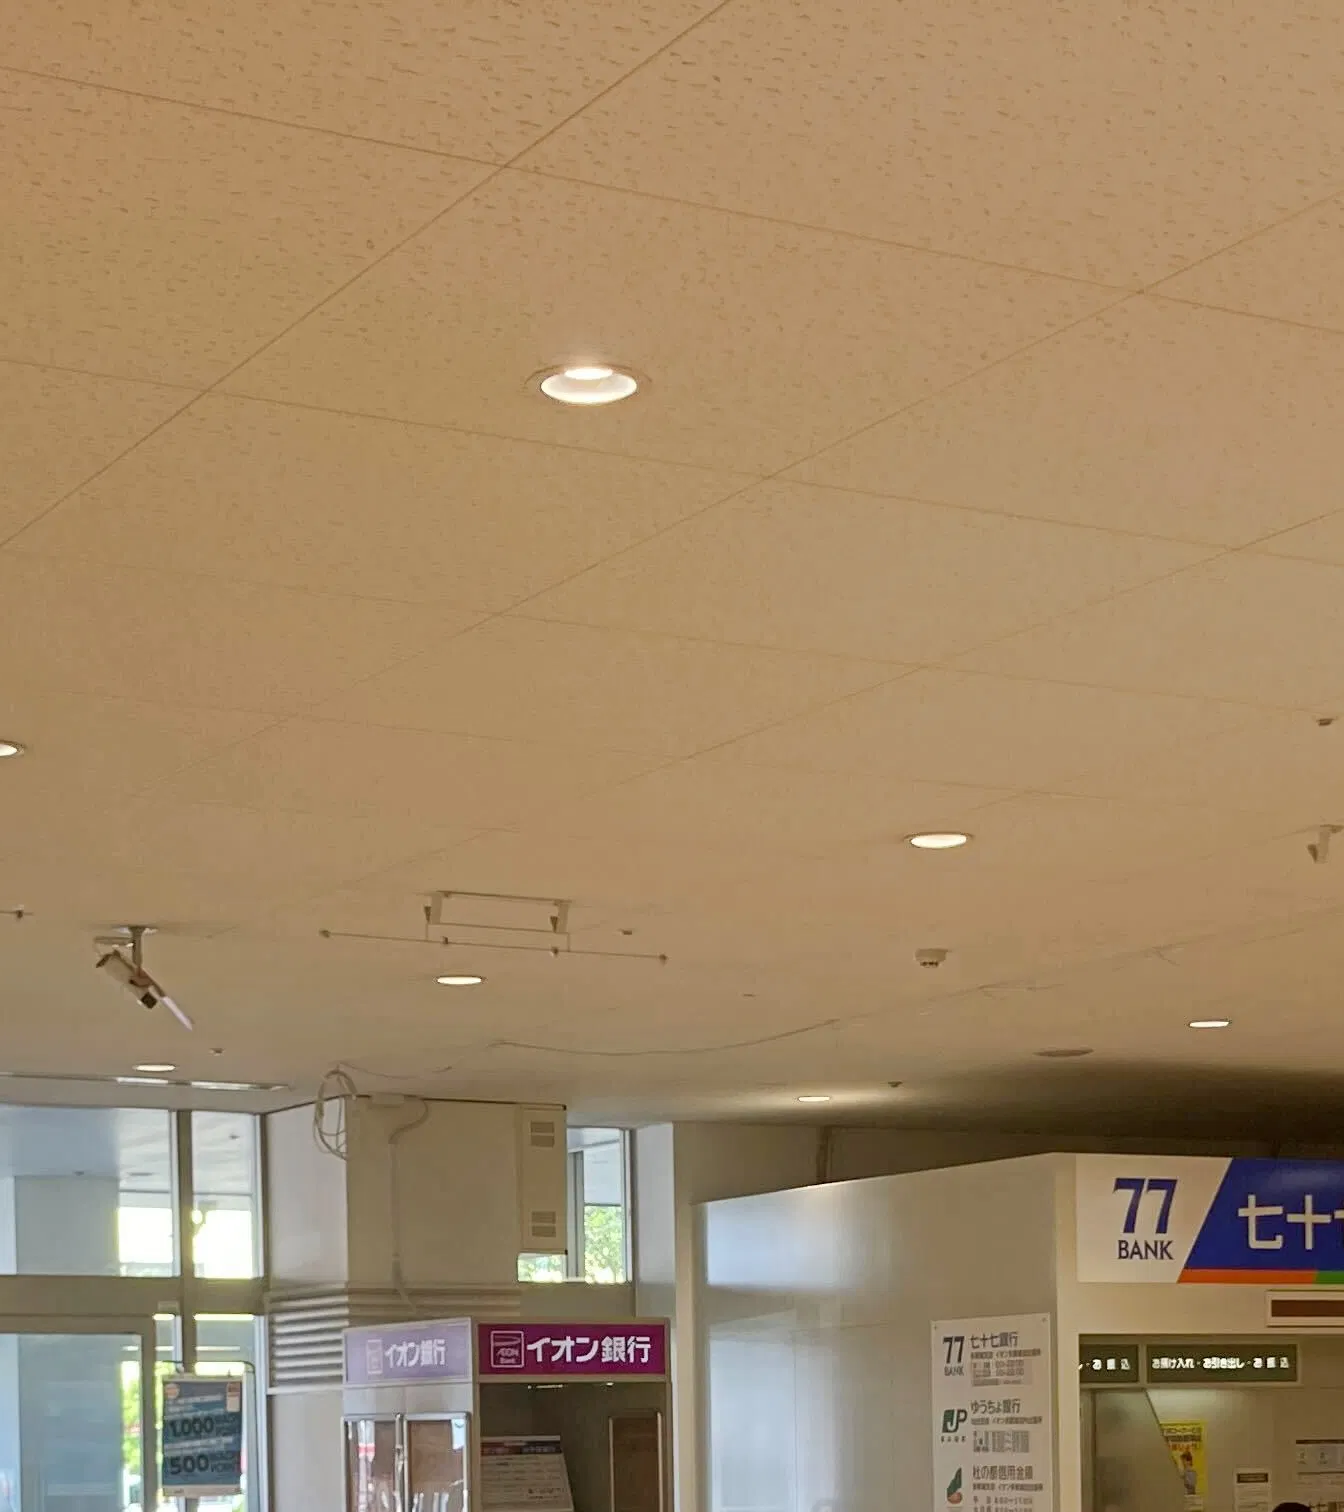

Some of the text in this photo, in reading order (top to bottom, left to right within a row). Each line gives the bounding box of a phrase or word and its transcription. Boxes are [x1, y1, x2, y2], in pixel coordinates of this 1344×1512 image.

[1112, 1177, 1178, 1235] 77
[1117, 1239, 1174, 1261] BANK
[526, 1336, 652, 1364] イオン銀行
[943, 1335, 965, 1364] 77
[970, 1331, 1018, 1349] 七十七銀行
[384, 1338, 446, 1368] イオン銀行
[970, 1399, 1021, 1415] ゆうちょ銀行
[170, 1454, 209, 1476] 500
